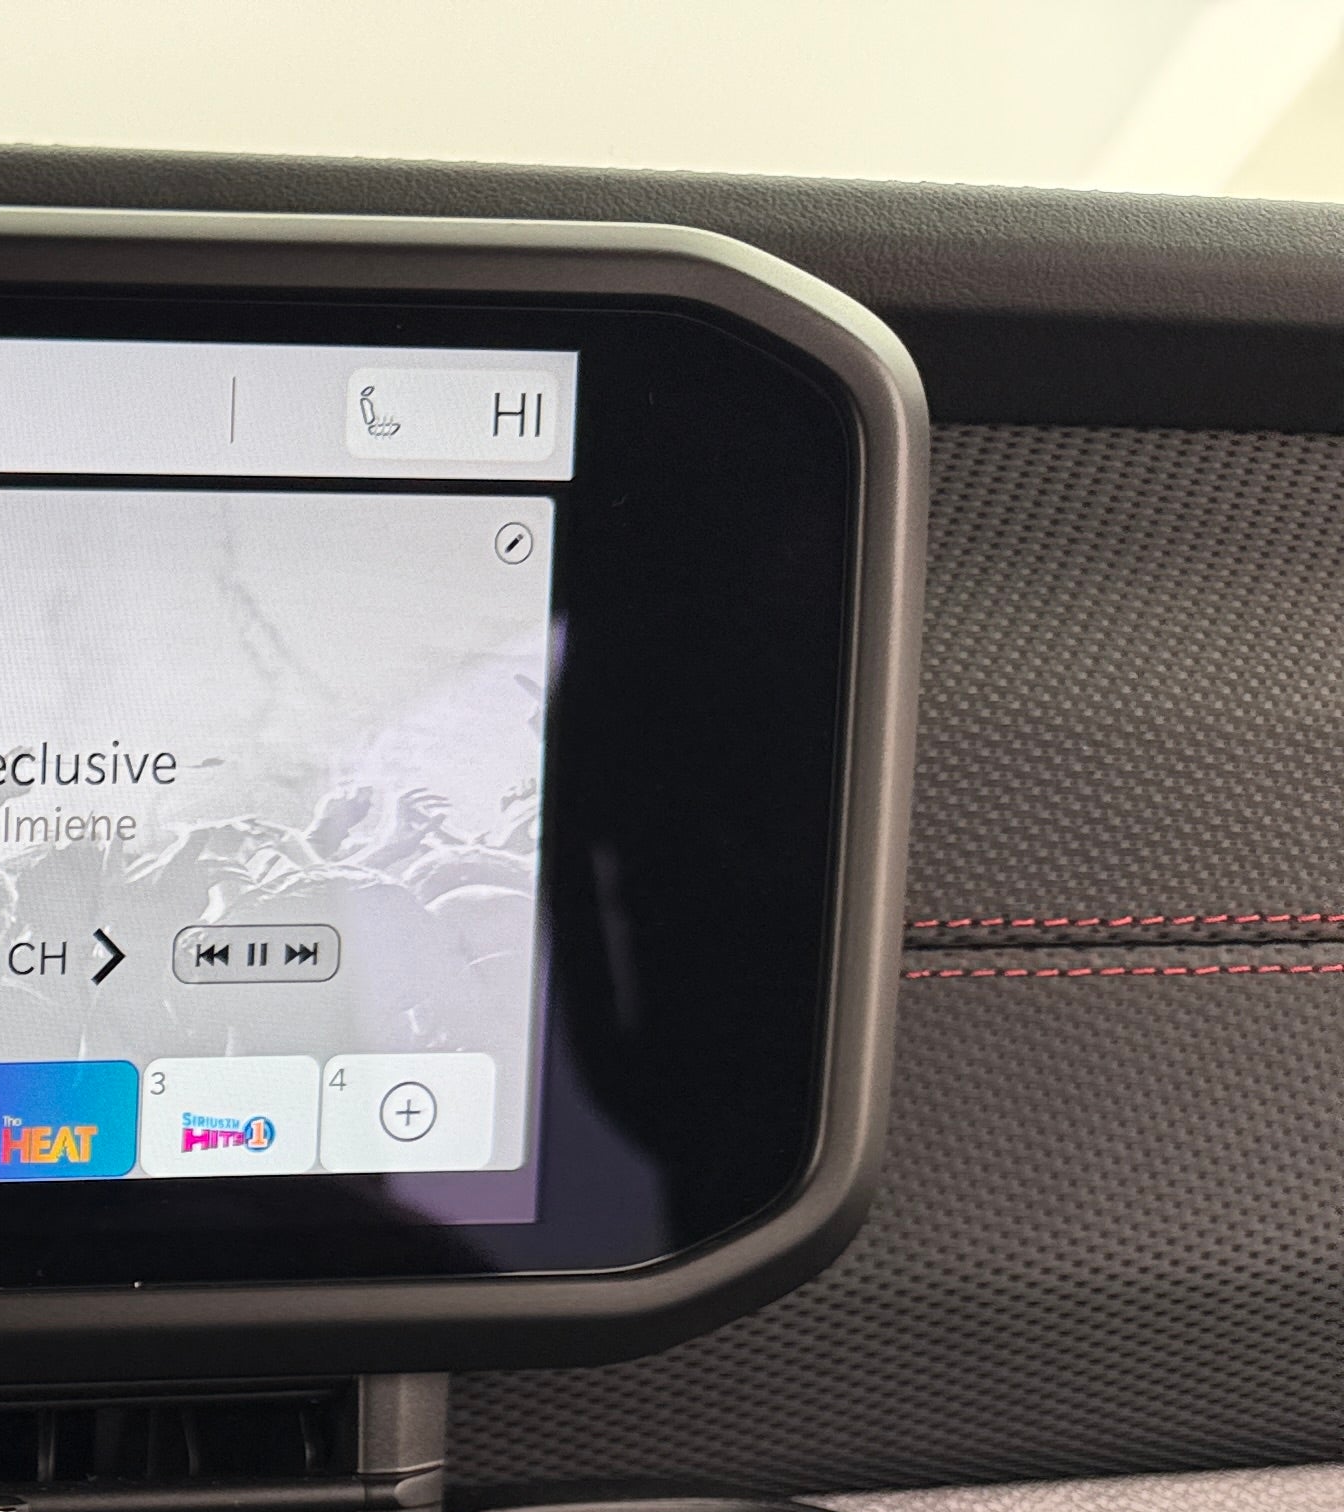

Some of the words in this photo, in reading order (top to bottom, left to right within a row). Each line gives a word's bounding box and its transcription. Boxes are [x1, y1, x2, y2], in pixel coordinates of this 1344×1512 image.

[492, 391, 543, 438] HI
[7, 941, 68, 977] CH
[148, 1071, 167, 1096] 3
[328, 1067, 348, 1092] 4
[0, 1125, 99, 1164] HEAT
